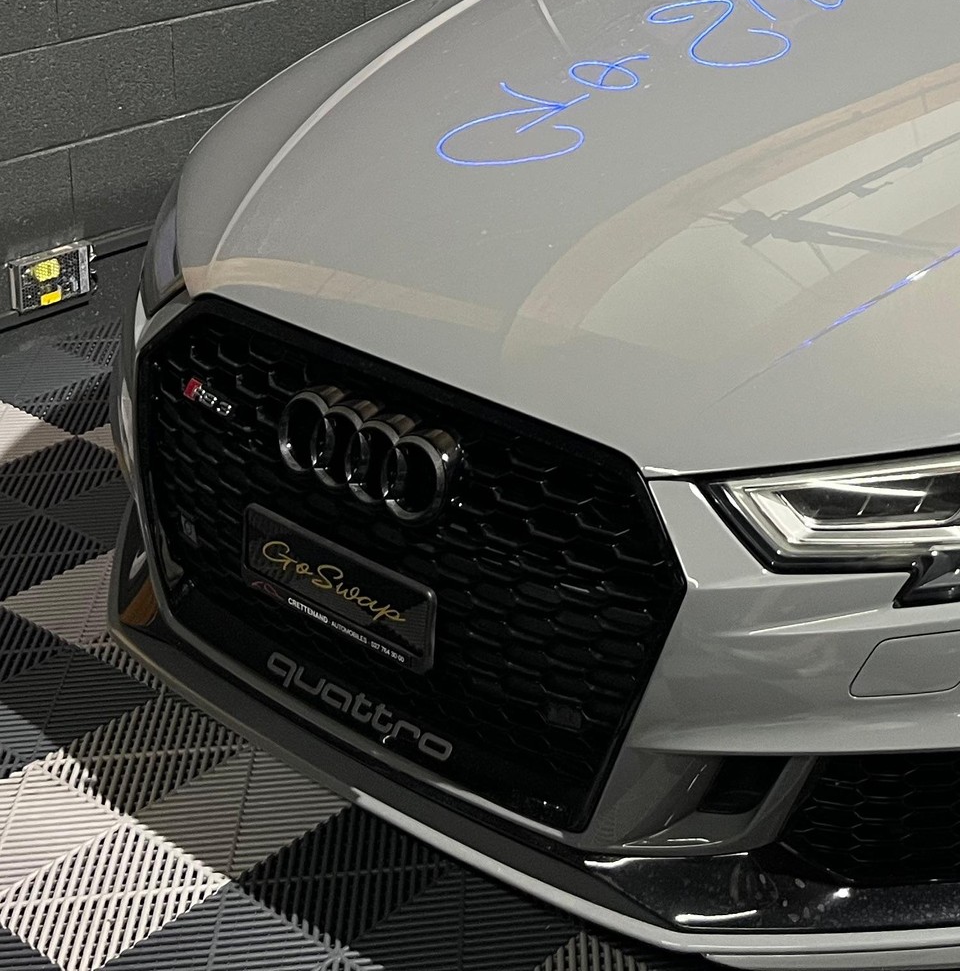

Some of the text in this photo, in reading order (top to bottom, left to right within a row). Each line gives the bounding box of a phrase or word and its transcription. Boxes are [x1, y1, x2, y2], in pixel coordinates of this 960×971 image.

[288, 597, 328, 623] CRETTENAND
[331, 621, 367, 643] AUTOMOBILES
[267, 652, 453, 761] quattro
